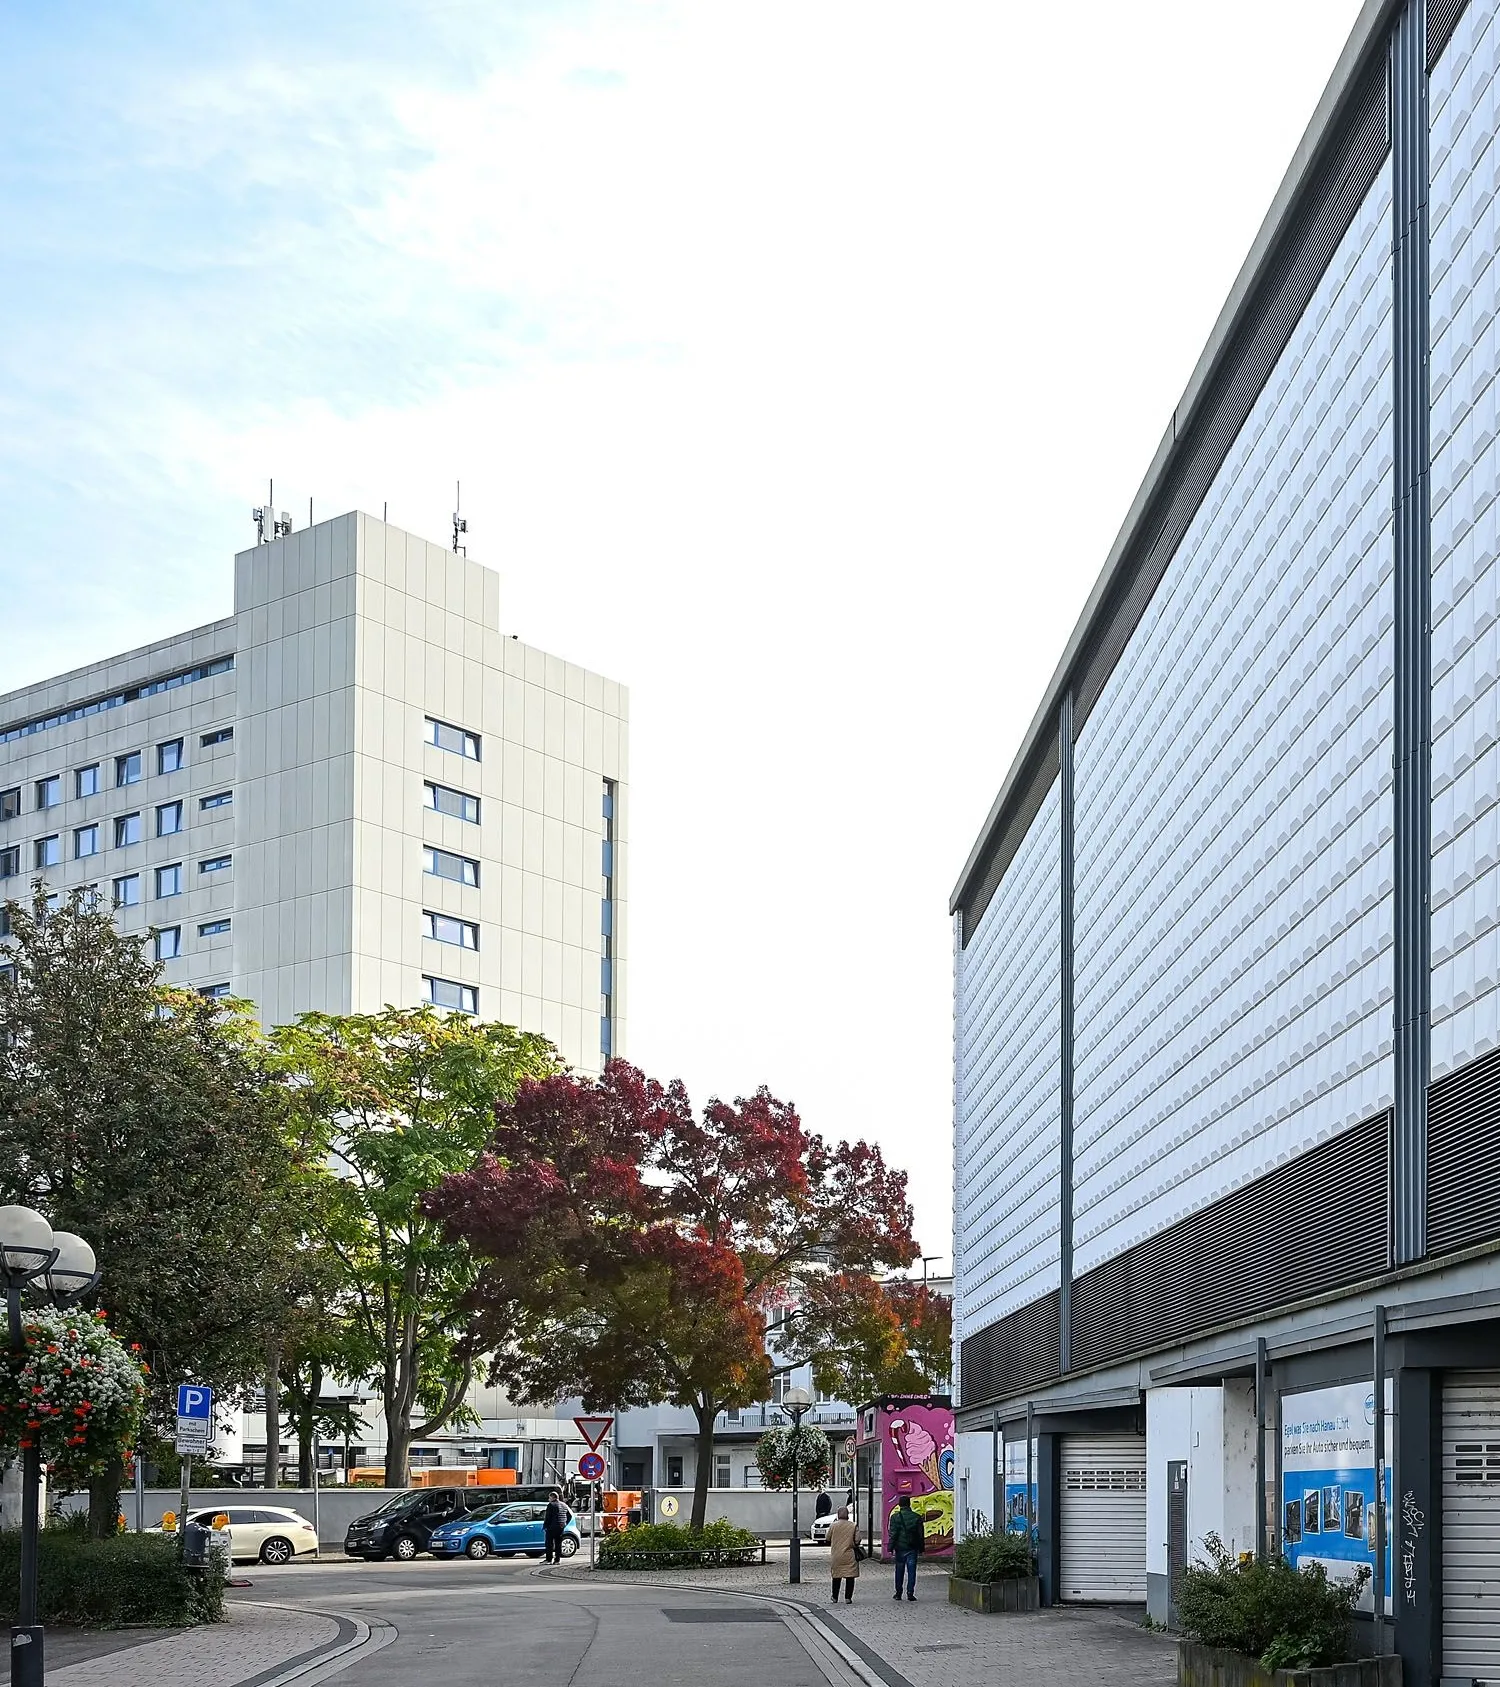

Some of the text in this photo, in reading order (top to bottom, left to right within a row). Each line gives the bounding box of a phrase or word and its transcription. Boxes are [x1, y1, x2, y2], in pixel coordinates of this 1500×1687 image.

[185, 1389, 203, 1414] P
[1284, 1423, 1293, 1437] Egal
[1294, 1424, 1302, 1434] was
[1309, 1420, 1321, 1433] nach
[1321, 1419, 1336, 1432] Hanau
[847, 1442, 854, 1452] 30
[1284, 1444, 1299, 1458] parken
[1312, 1441, 1324, 1453] Auto
[1324, 1440, 1339, 1453] sicher
[1339, 1438, 1348, 1451] und
